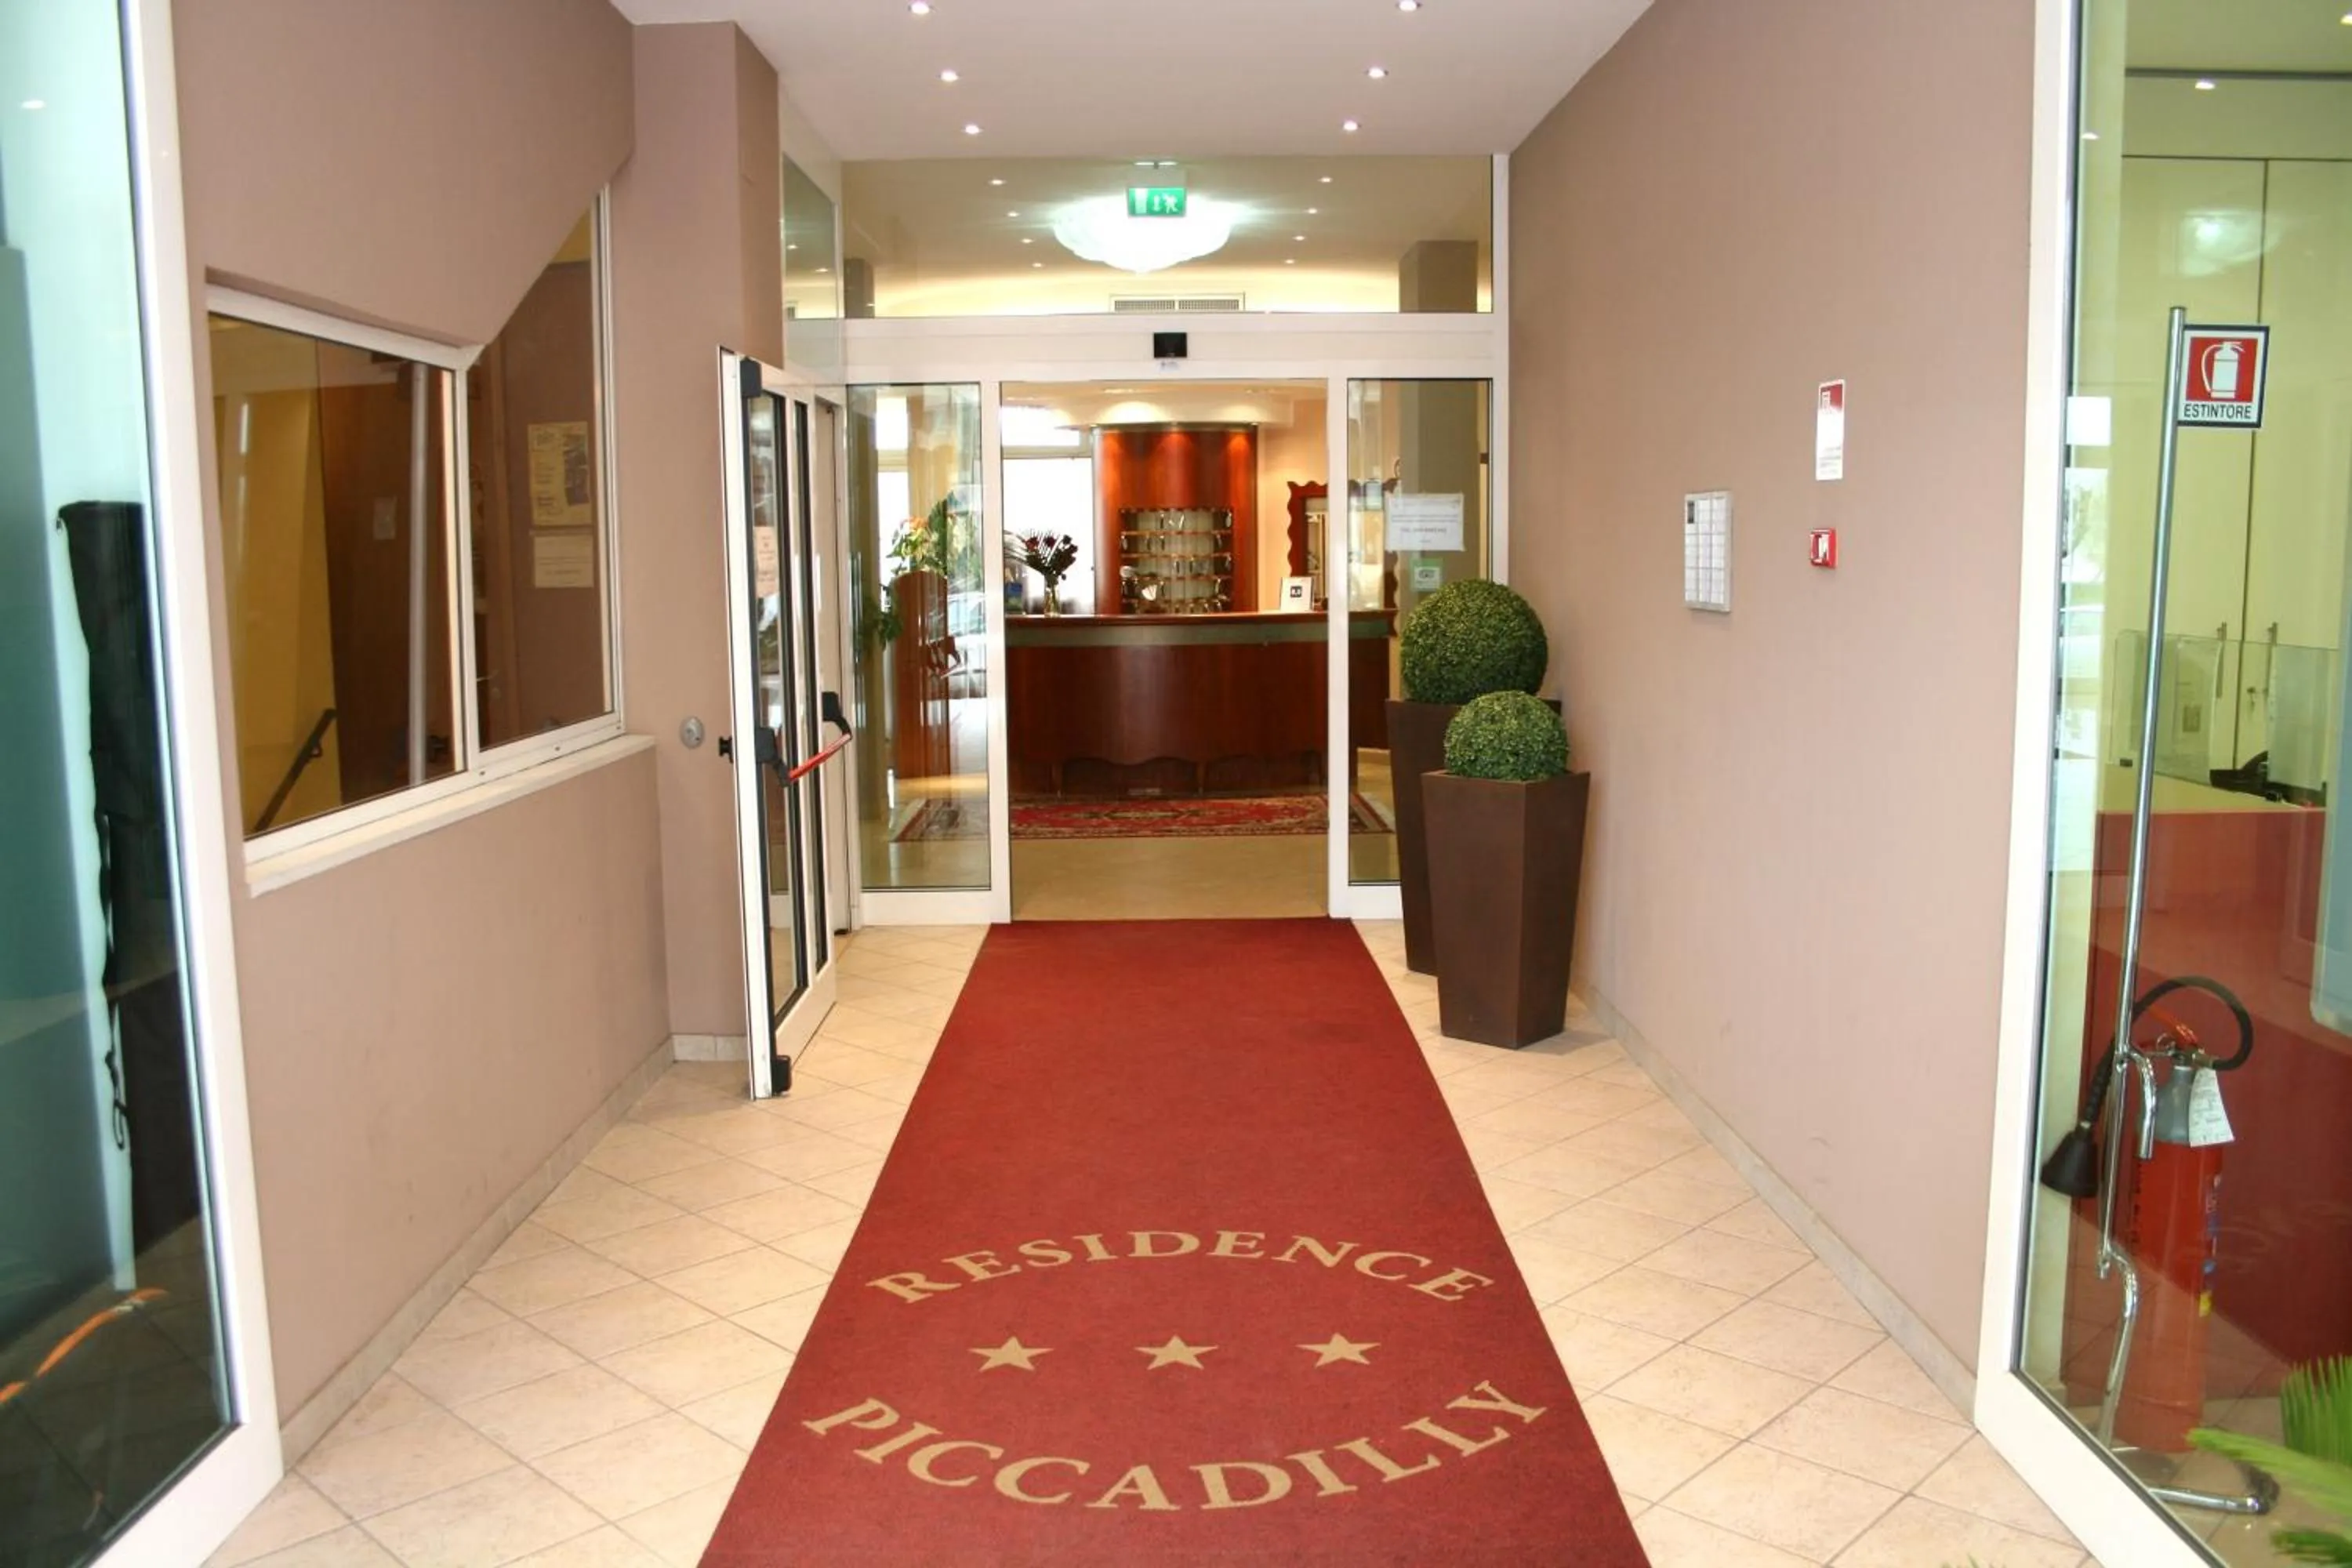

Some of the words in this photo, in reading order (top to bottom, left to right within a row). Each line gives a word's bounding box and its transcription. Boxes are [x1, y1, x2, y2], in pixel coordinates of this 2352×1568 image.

[2183, 403, 2252, 419] ESTINTORE
[865, 1231, 1494, 1303] RESIDENCE
[802, 1380, 1547, 1510] PICCADILLY
